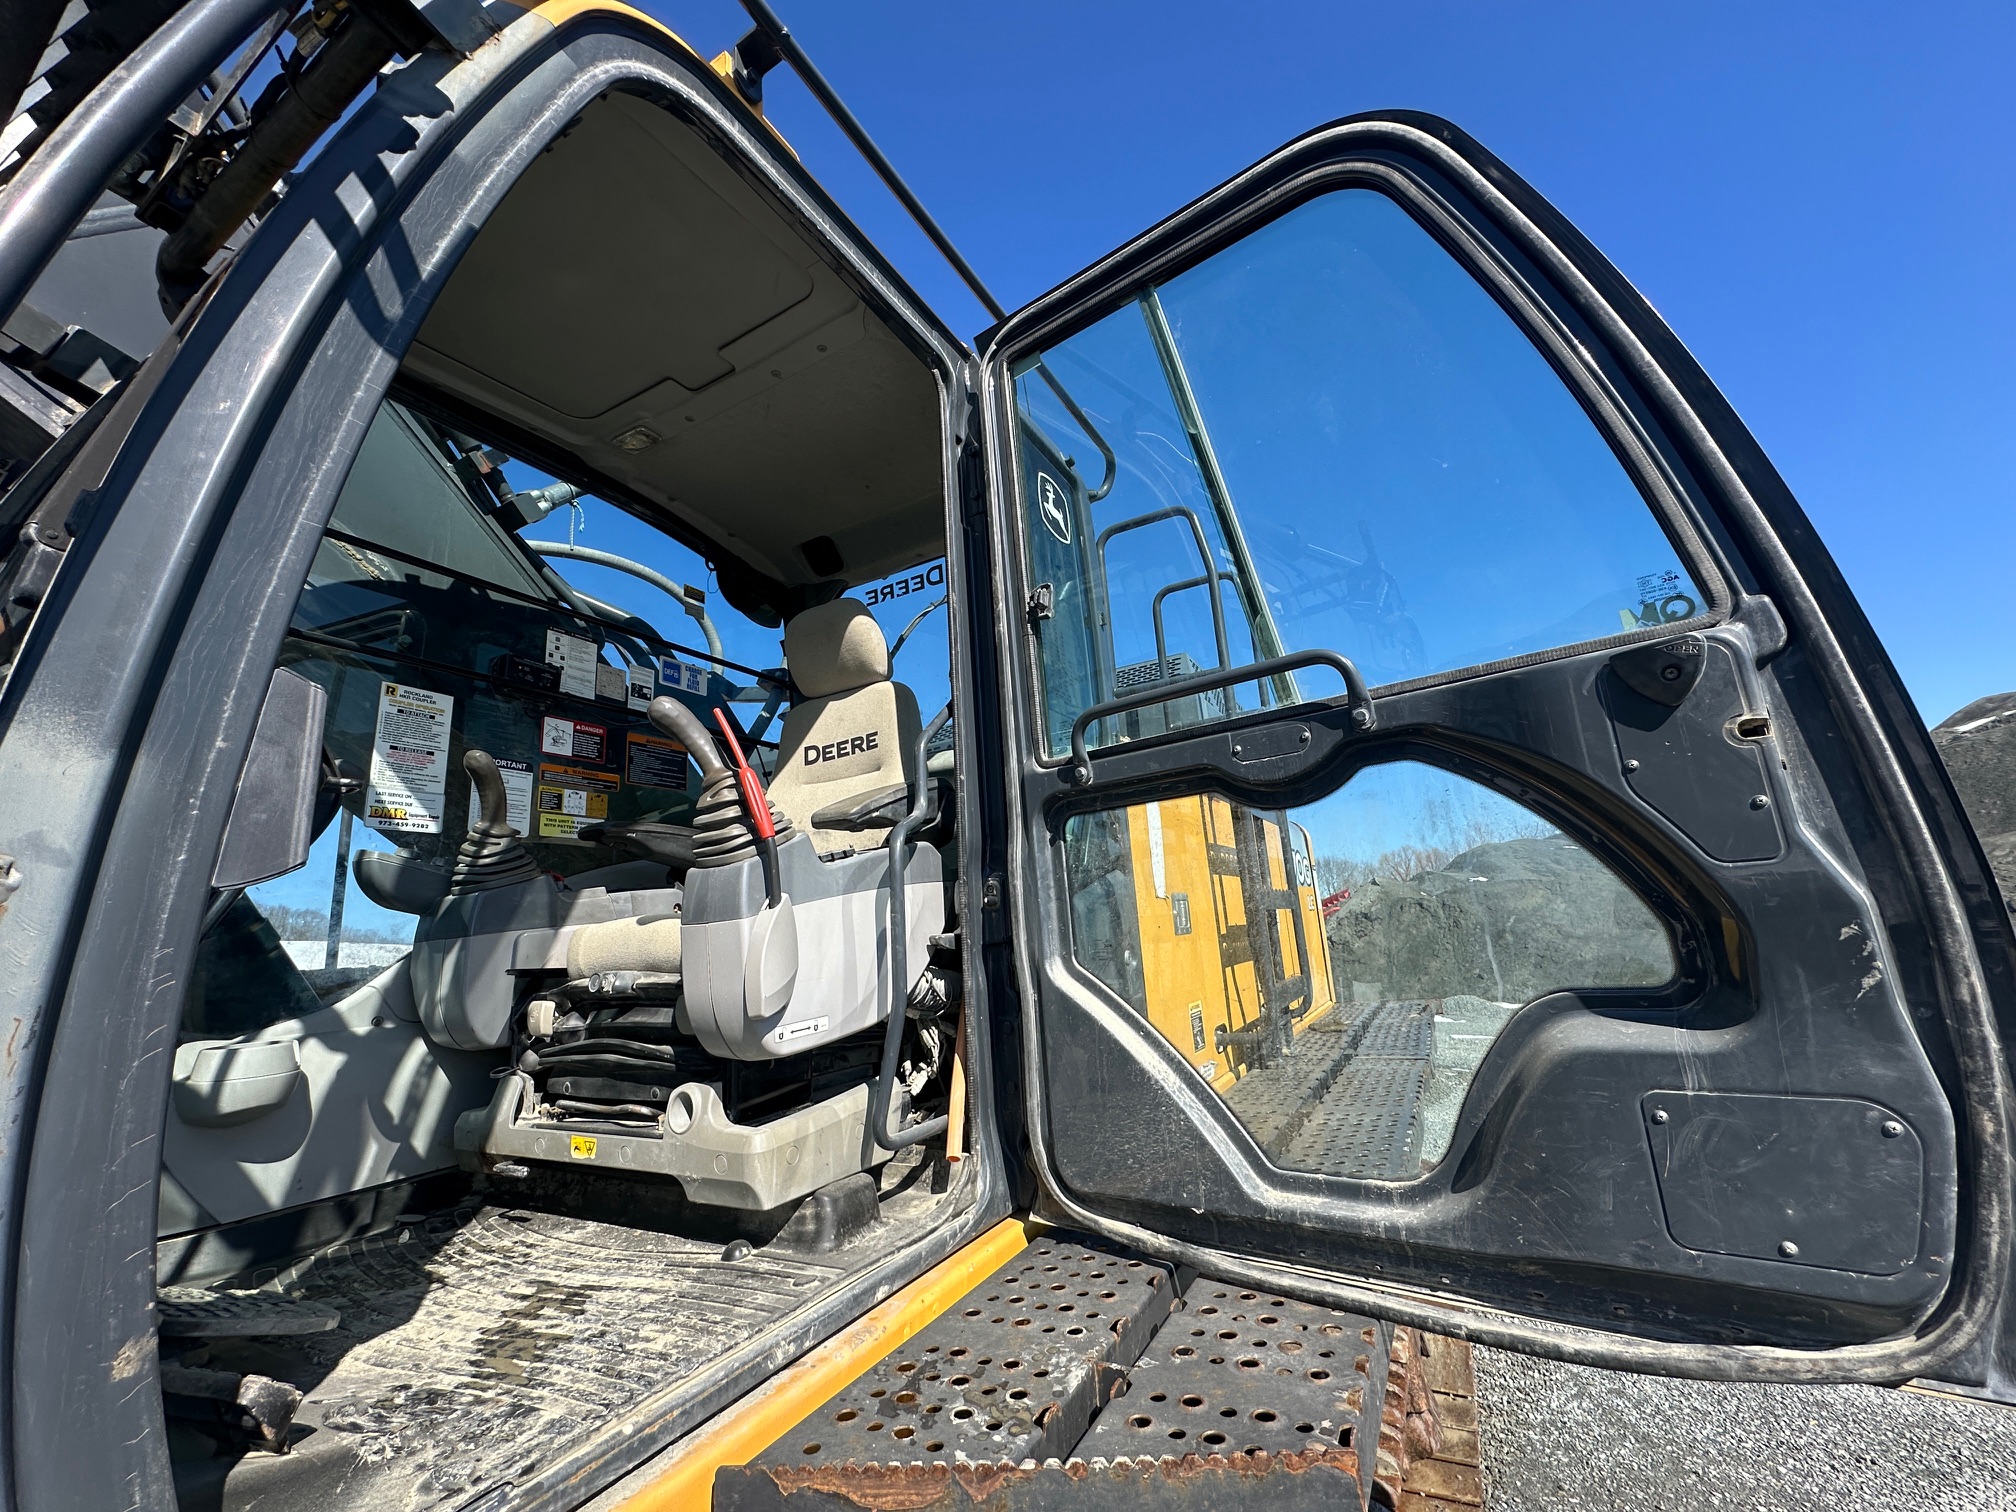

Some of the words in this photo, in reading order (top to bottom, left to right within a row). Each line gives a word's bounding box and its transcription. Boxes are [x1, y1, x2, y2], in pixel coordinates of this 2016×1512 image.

[1664, 645, 1698, 653] OPEN
[386, 685, 396, 696] R
[403, 690, 433, 700] ROCKLAND
[412, 696, 437, 706] COUPLER
[581, 725, 604, 734] DANGER
[649, 739, 673, 748] WARNING
[804, 731, 879, 766] DEERE
[493, 758, 528, 770] ORTANT
[572, 768, 600, 778] WARNING
[369, 805, 408, 820] DMR
[378, 820, 429, 829] 973-459-9282
